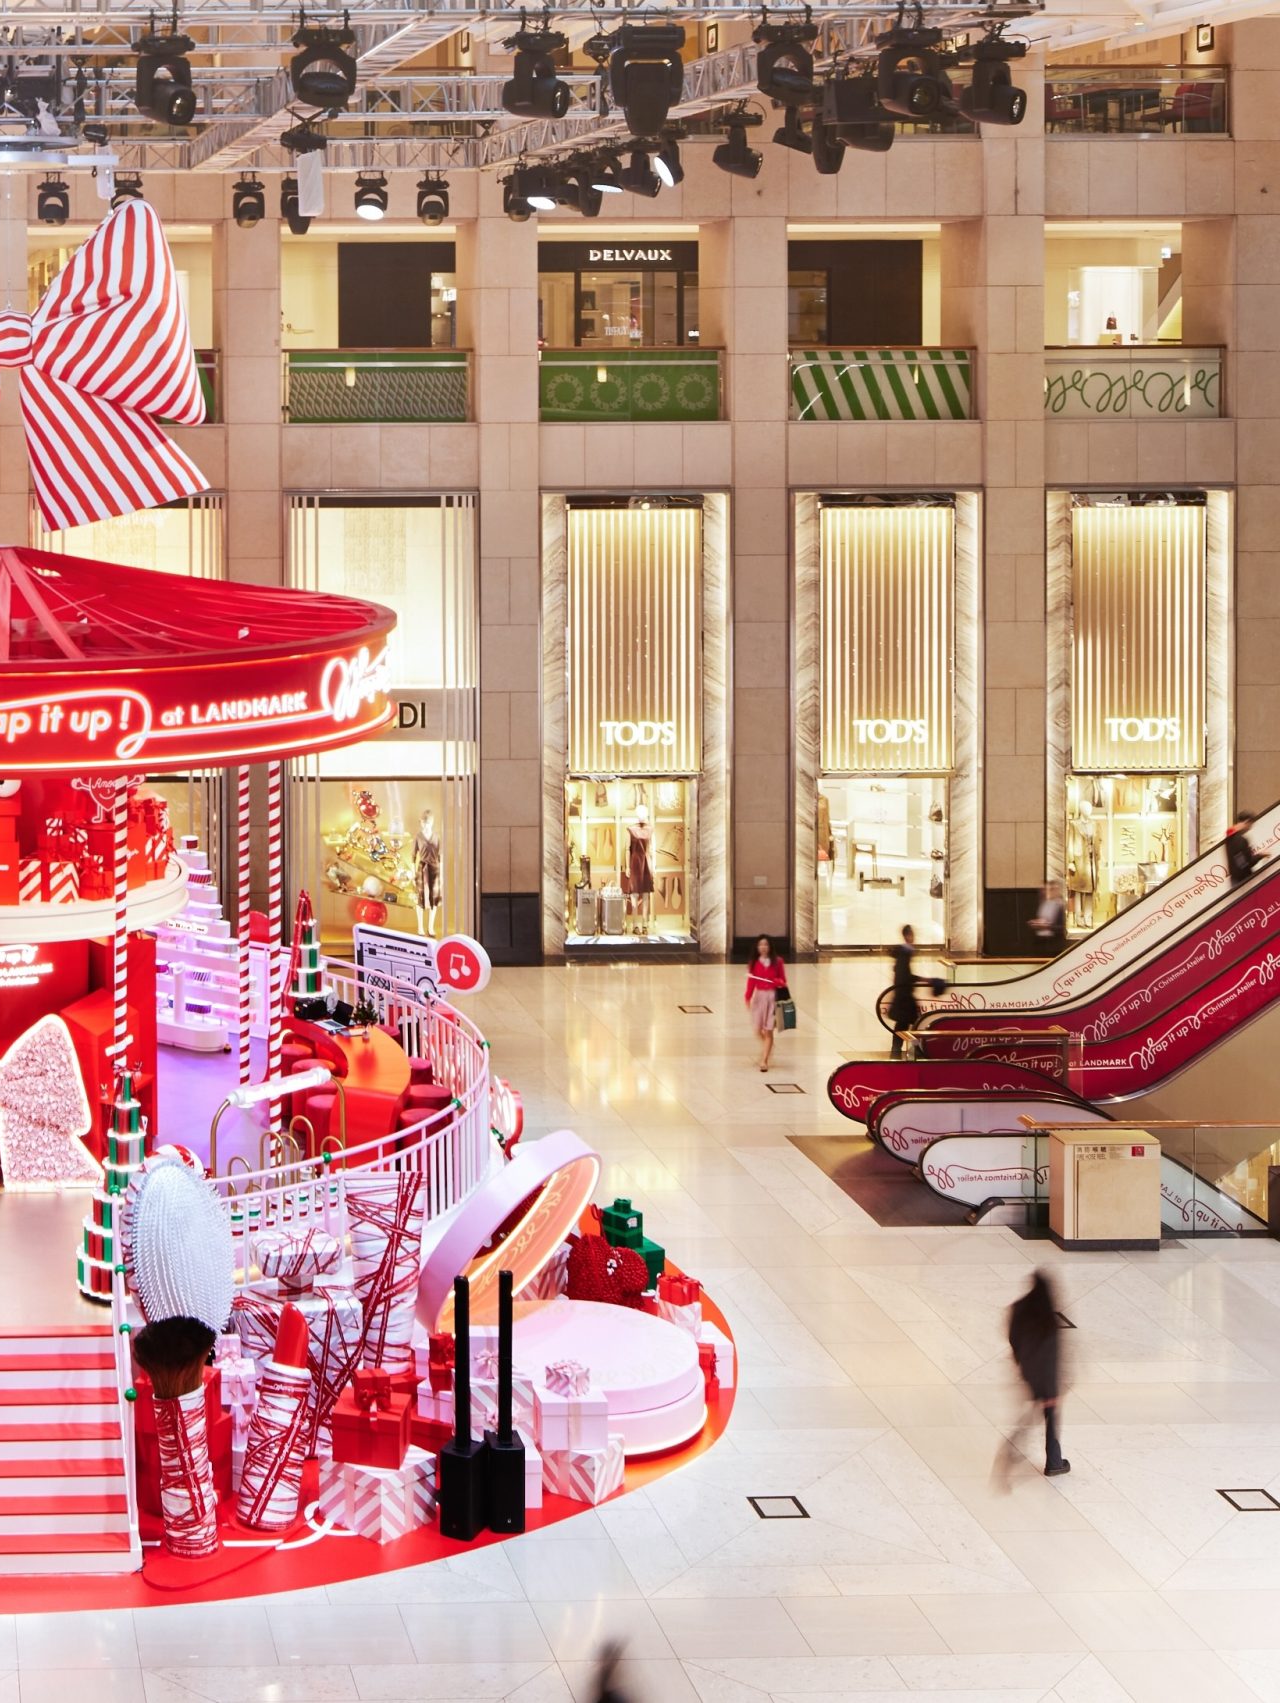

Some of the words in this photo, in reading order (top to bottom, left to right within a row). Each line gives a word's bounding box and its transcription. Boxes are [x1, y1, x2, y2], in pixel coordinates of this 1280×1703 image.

[589, 249, 673, 261] DELVAUX
[160, 706, 185, 727] at
[190, 691, 308, 725] LANDMARK
[39, 704, 65, 734] it
[69, 709, 113, 741] up
[599, 720, 677, 746] TOD'S
[852, 718, 929, 744] TOD'S
[1104, 716, 1181, 742] TOD'S
[1159, 967, 1187, 989] Christmas
[1186, 953, 1206, 970] Atelier
[1207, 993, 1237, 1015] Christmas
[1237, 978, 1257, 996] Atelier
[1079, 1058, 1127, 1067] LANDMARK
